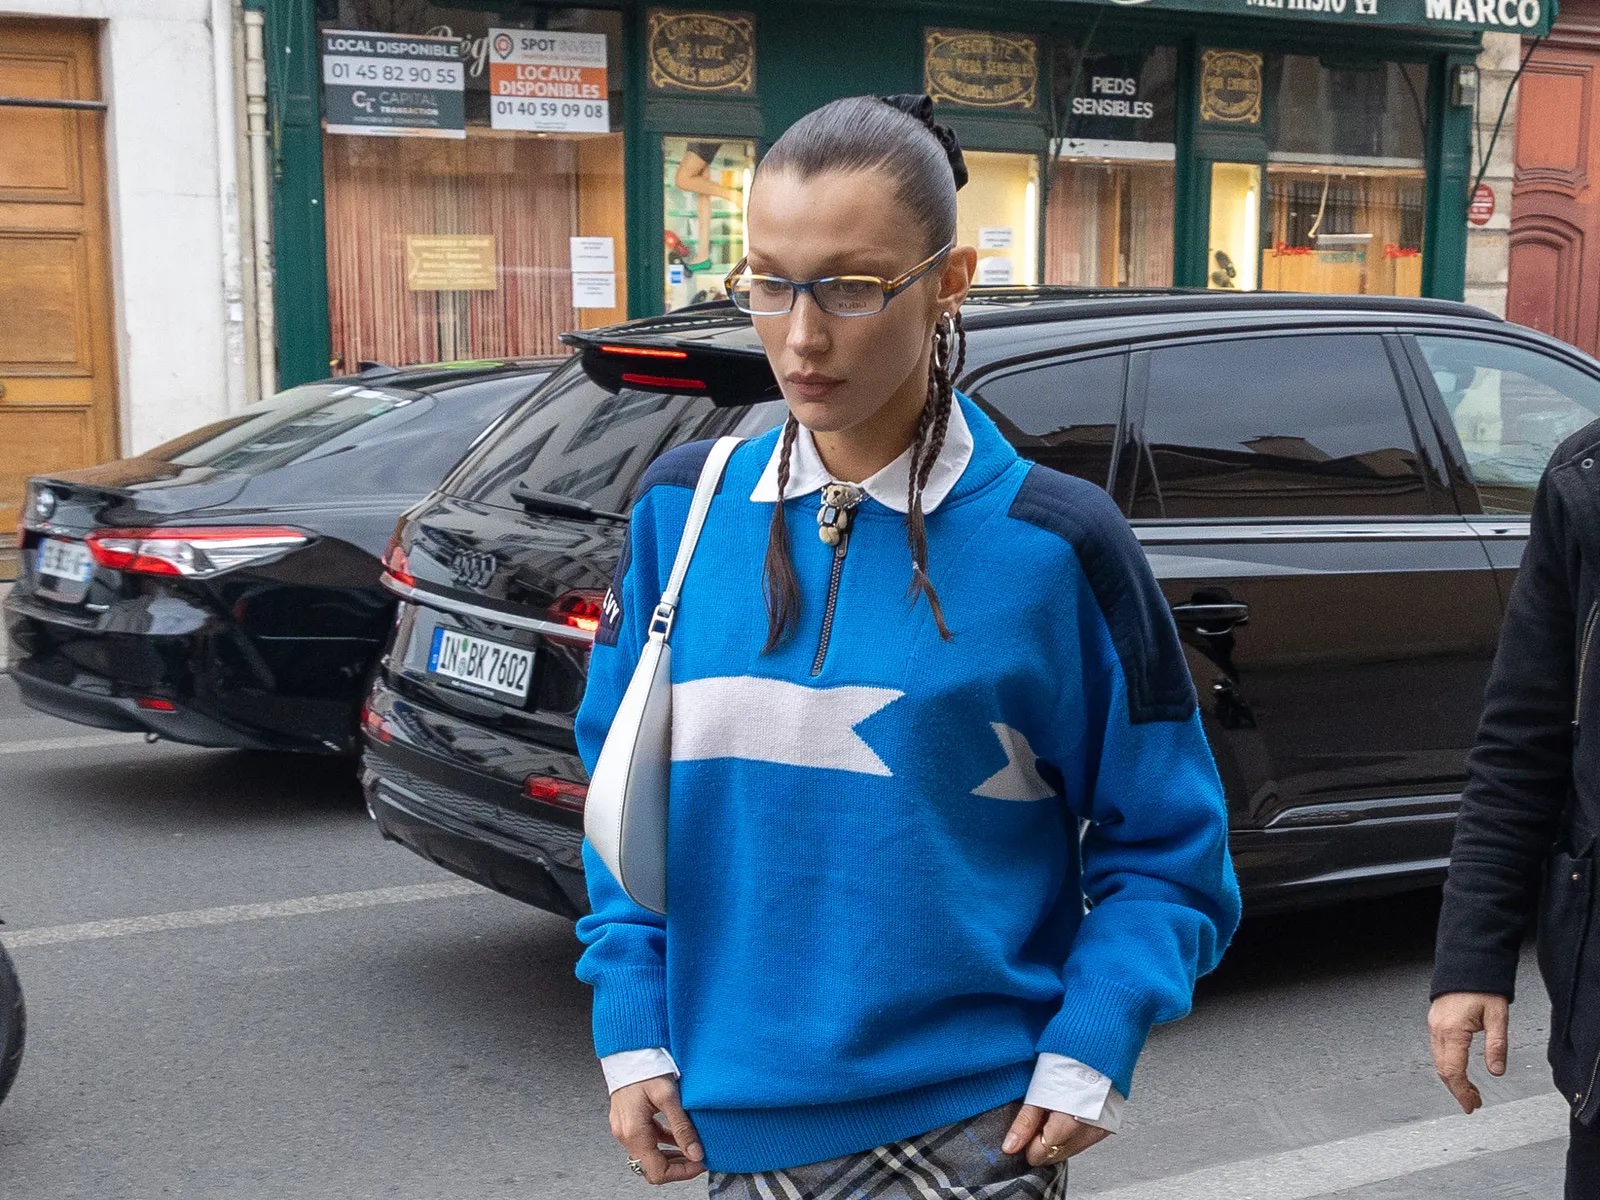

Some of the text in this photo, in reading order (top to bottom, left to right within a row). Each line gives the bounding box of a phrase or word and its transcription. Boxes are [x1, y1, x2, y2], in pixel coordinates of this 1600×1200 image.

[1425, 0, 1540, 27] MARCO
[327, 38, 459, 57] LOCAL DISPONIBLE
[521, 38, 555, 51] SPOT
[332, 63, 456, 84] 01 45 82 90 55
[516, 65, 582, 82] LOCAUX
[499, 80, 600, 99] DISPONIBLES
[1092, 76, 1136, 96] PIEDS
[497, 101, 603, 119] 01 40 59 09 08
[1072, 97, 1153, 119] SENSIBLES
[440, 635, 461, 673] IN
[466, 642, 490, 681] BK
[487, 647, 528, 692] 7602
